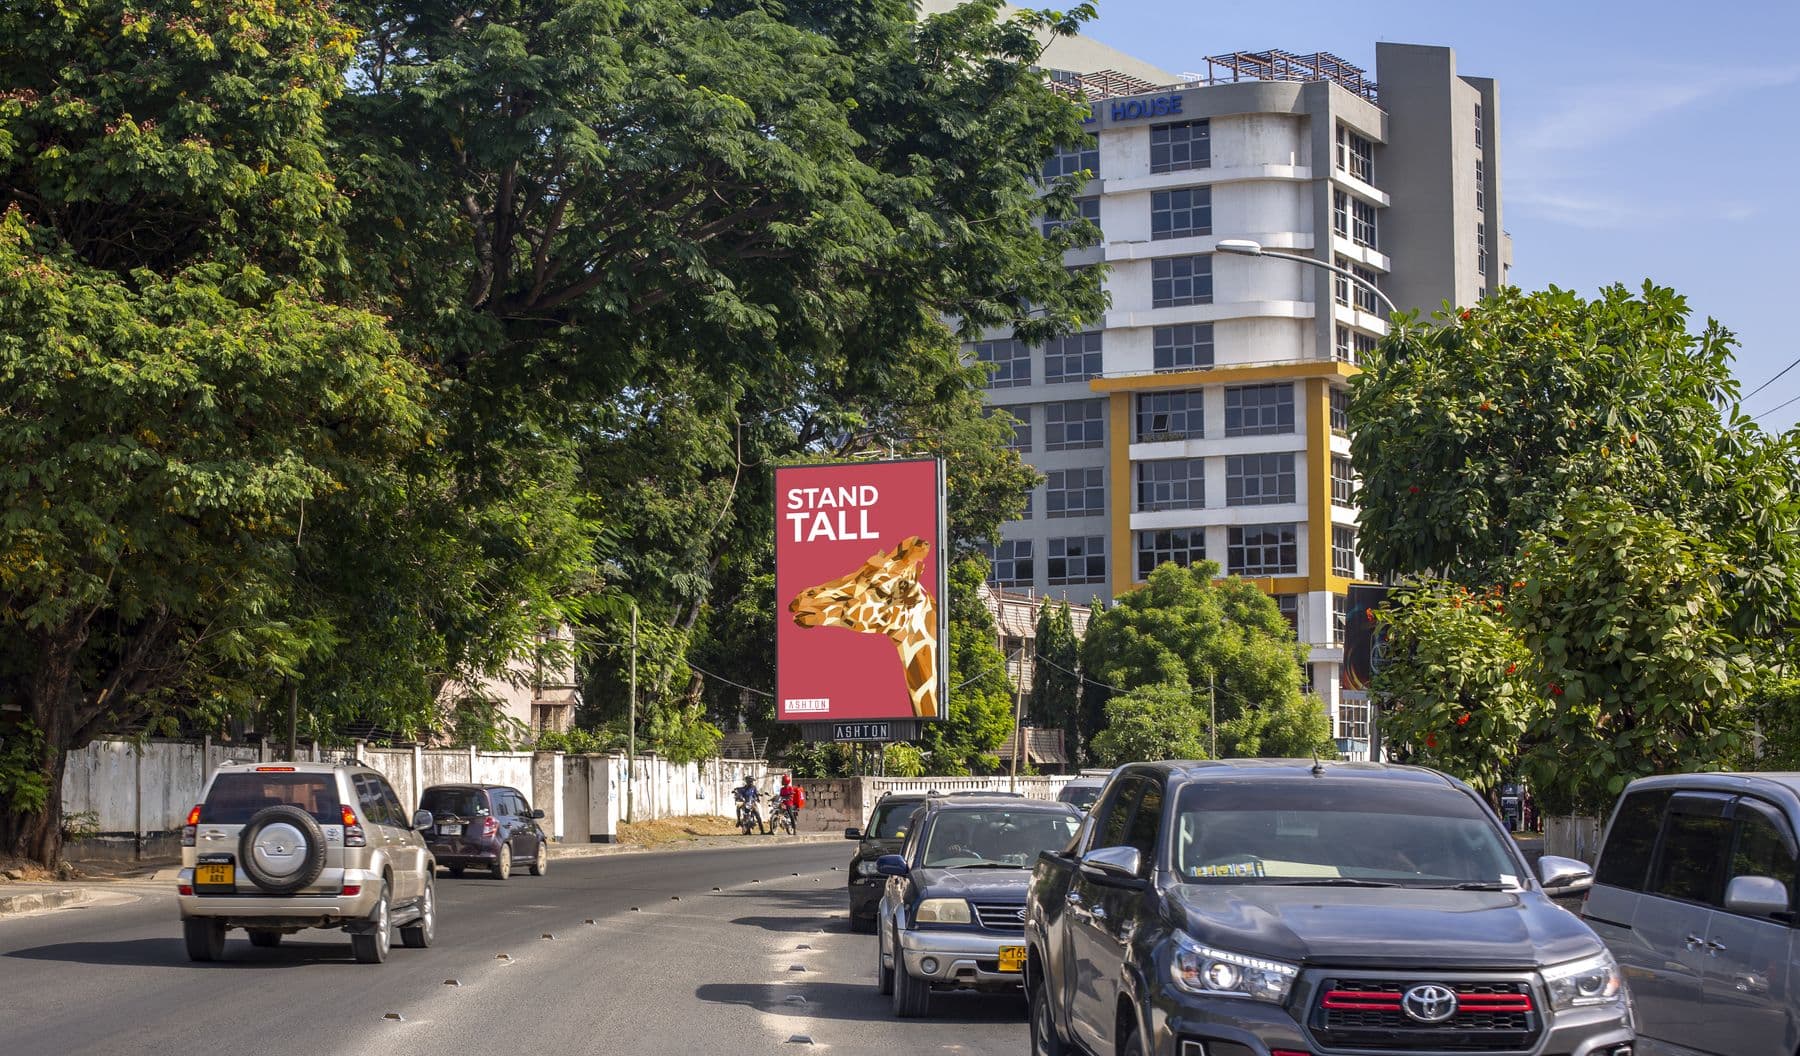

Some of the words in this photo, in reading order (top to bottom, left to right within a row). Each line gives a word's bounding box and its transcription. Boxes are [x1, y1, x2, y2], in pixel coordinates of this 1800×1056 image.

[1111, 95, 1183, 121] HOUSE
[787, 485, 879, 509] STAND
[786, 509, 880, 543] TALL
[788, 700, 827, 710] ASHTON
[836, 725, 887, 738] ASHTON
